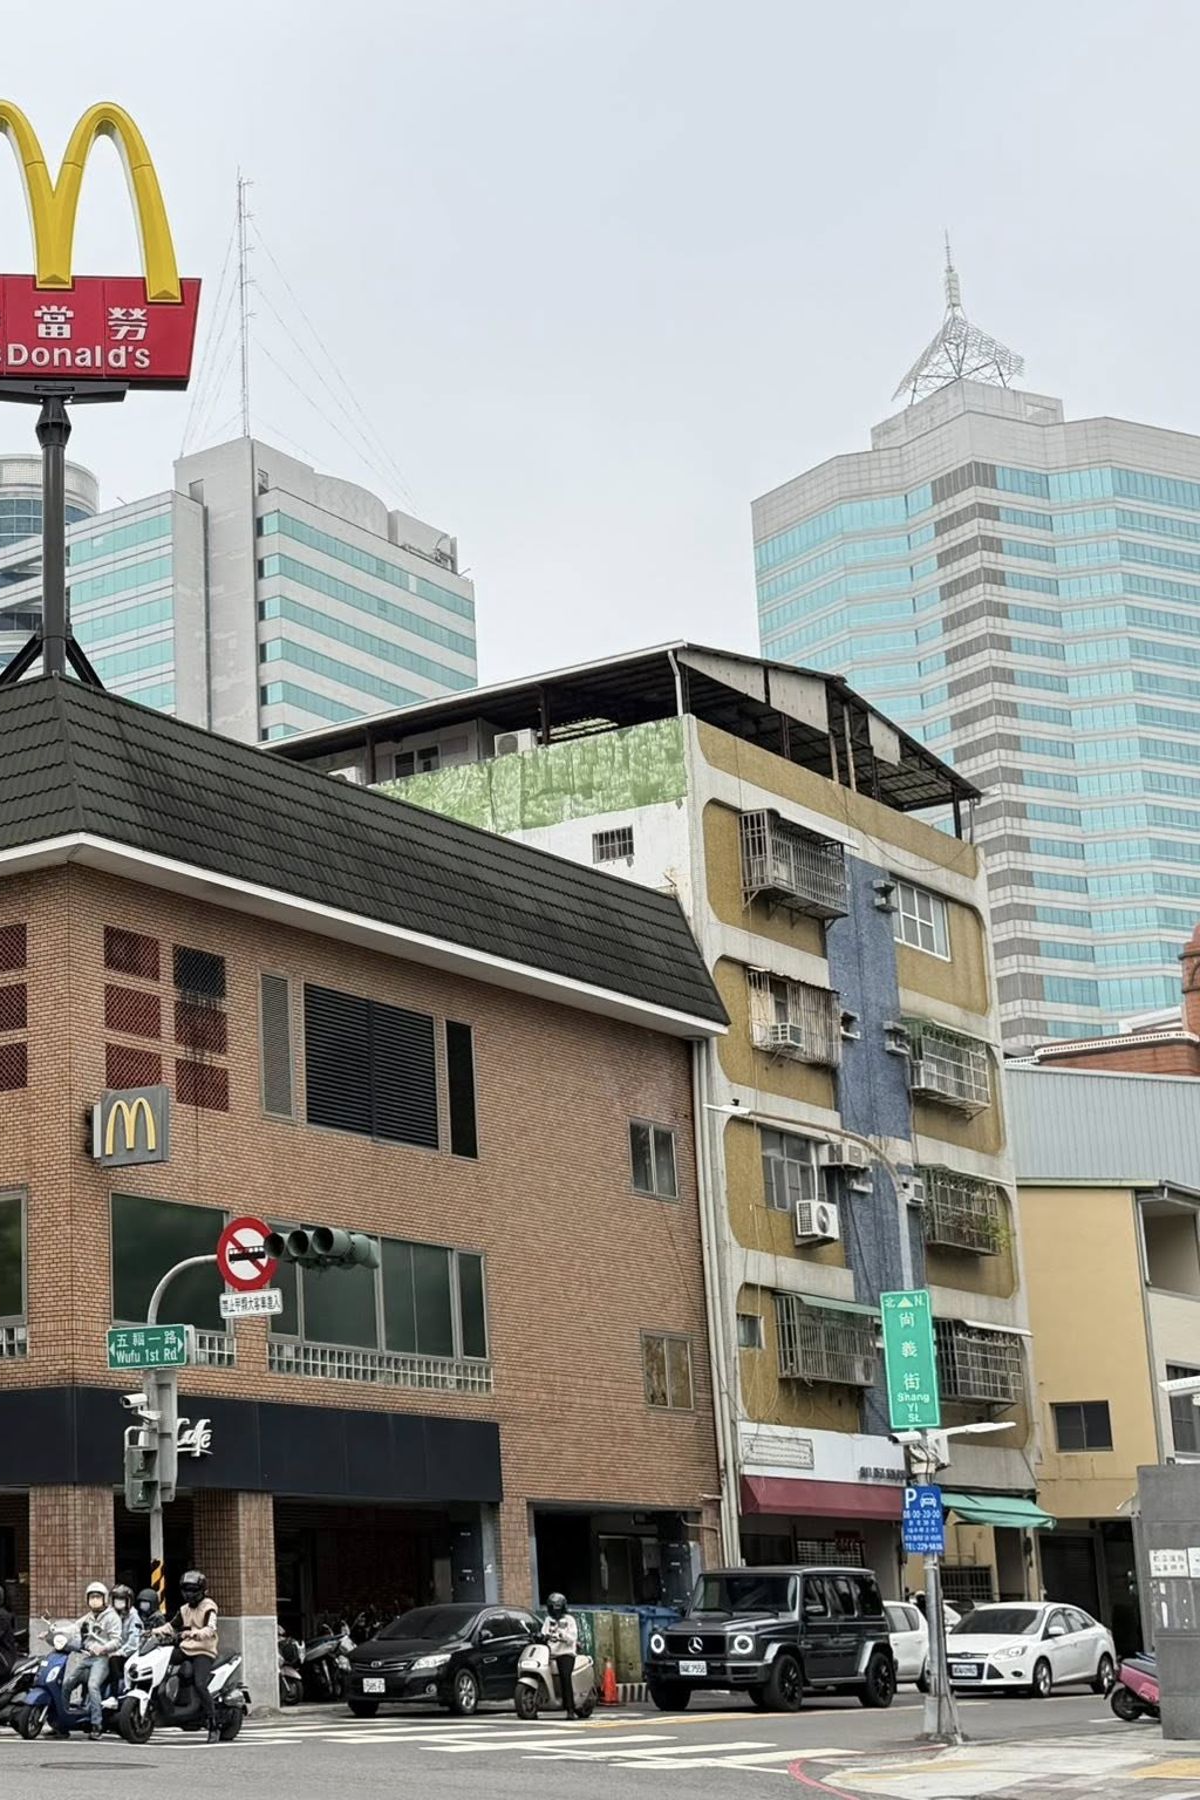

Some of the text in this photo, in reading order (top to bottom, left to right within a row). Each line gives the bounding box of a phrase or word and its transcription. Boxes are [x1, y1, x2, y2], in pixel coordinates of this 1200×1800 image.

[116, 1330, 177, 1348] 五福一路
[116, 1349, 141, 1364] Wufu
[145, 1348, 160, 1362] 1st
[900, 1311, 921, 1391] 尚義街
[897, 1392, 930, 1403] Shang
[905, 1488, 917, 1509] P
